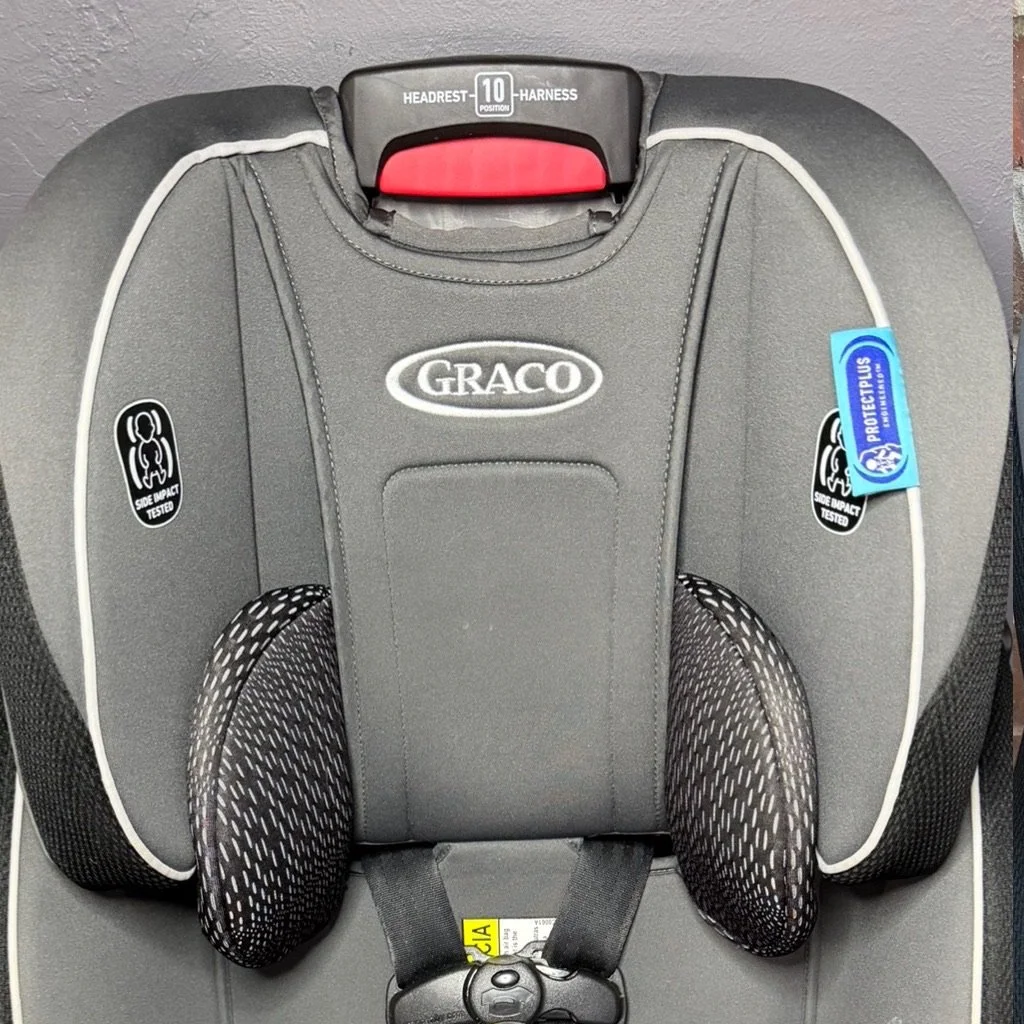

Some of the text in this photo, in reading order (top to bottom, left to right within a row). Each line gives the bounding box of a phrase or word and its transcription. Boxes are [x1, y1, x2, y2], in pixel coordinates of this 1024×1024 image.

[403, 78, 578, 104] HEADREST 10 HARNESS
[479, 104, 510, 113] POSITION
[417, 359, 582, 396] GRACO
[857, 356, 881, 443] PROTECTPLUS
[135, 483, 179, 511] SIDE IMPACT
[146, 500, 174, 520] TESTED
[814, 491, 861, 517] SIDE IMPACT
[821, 507, 849, 527] TESTED
